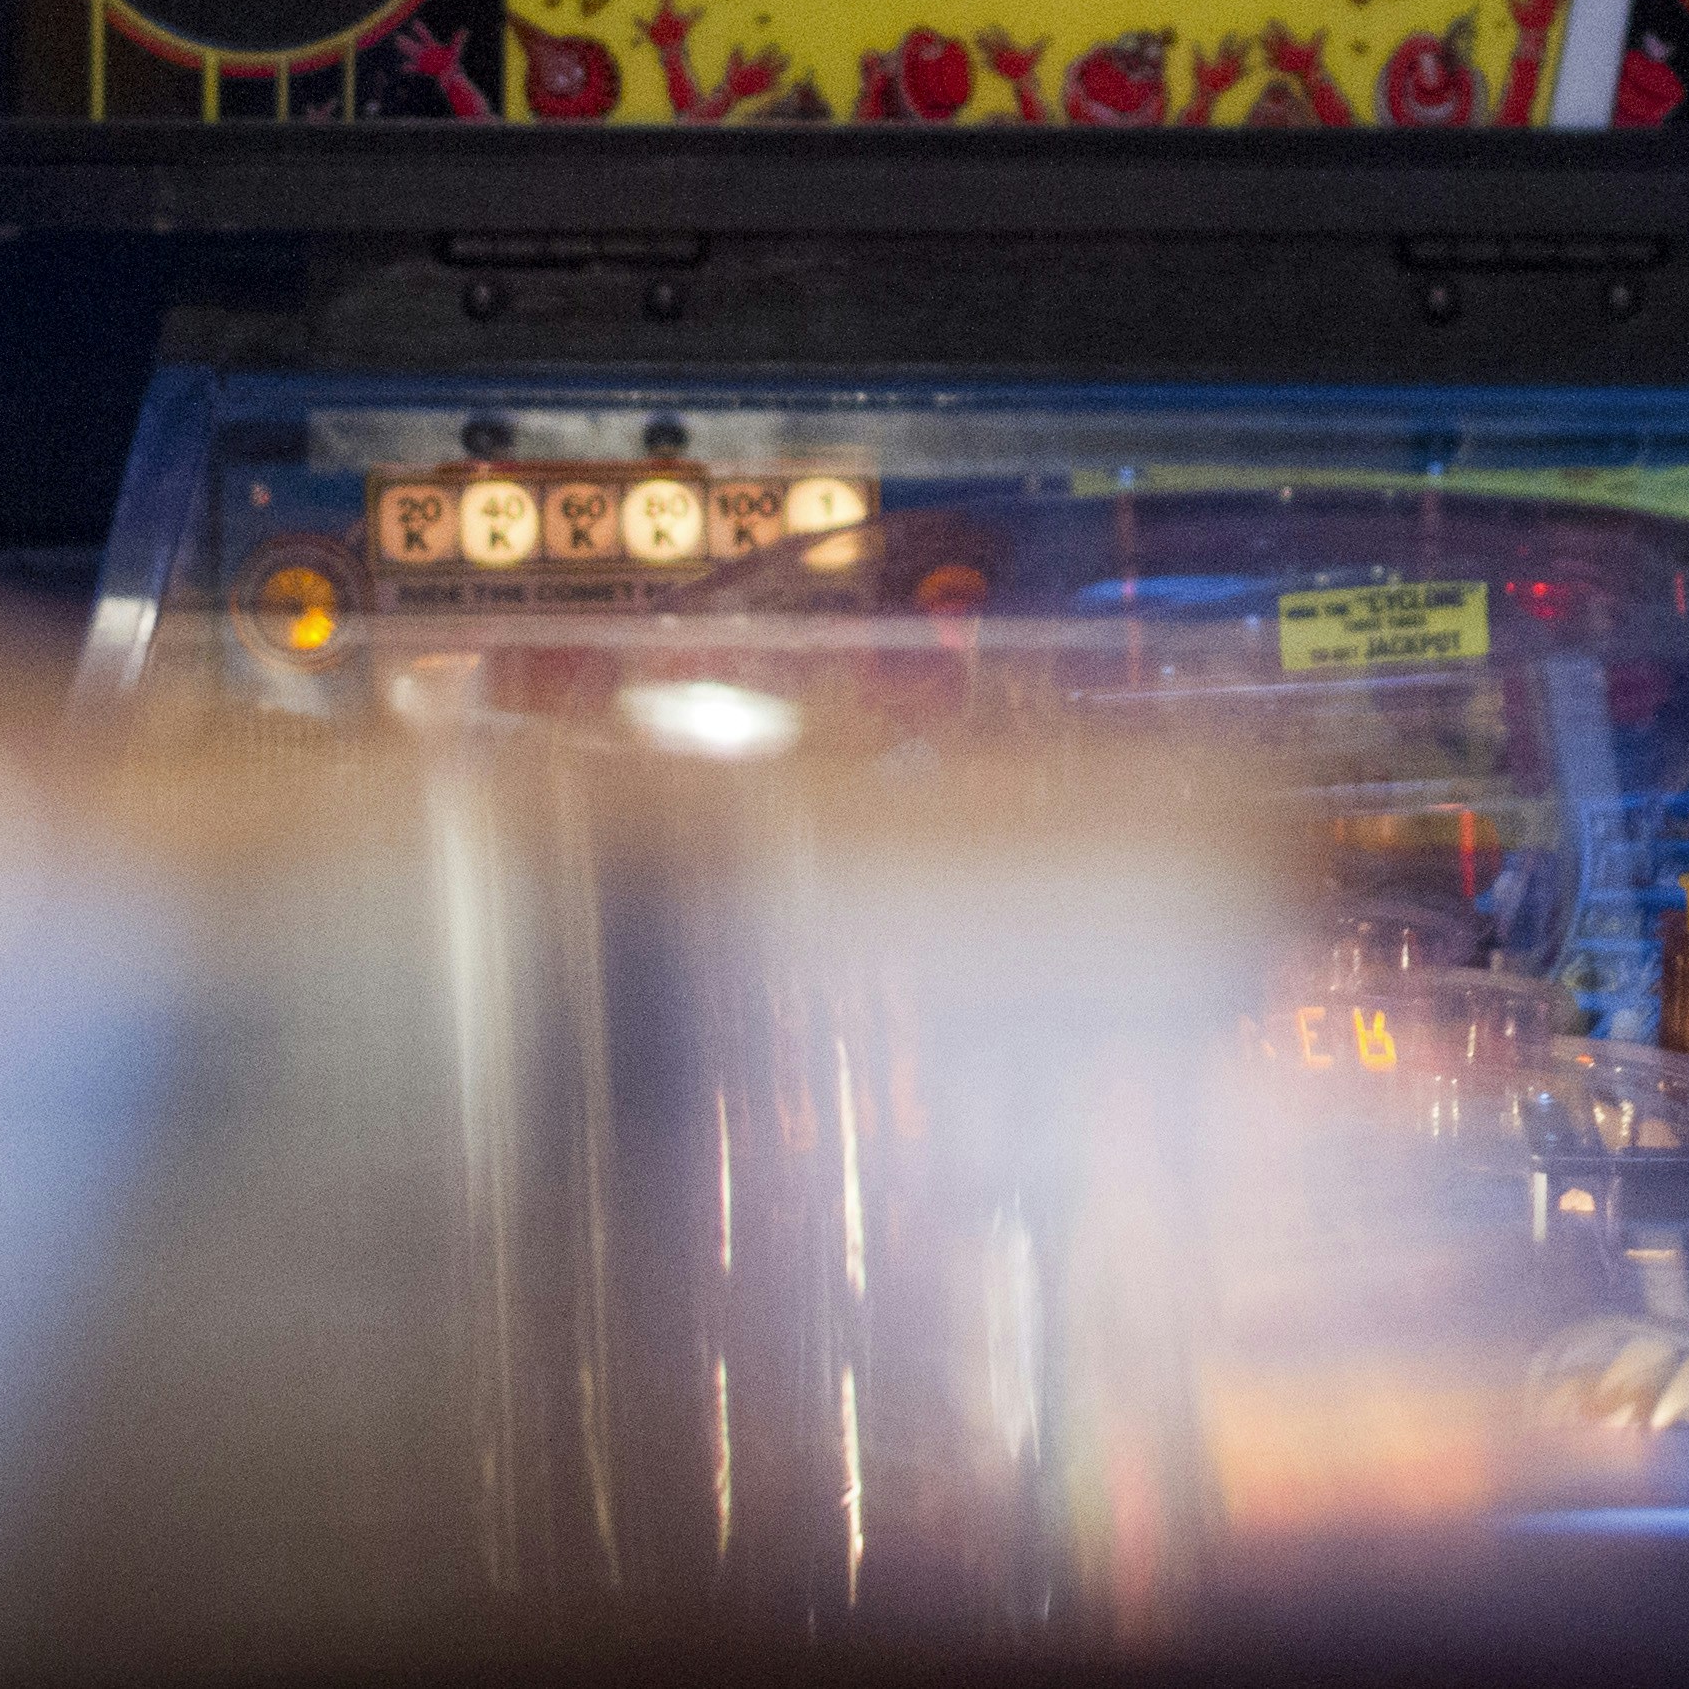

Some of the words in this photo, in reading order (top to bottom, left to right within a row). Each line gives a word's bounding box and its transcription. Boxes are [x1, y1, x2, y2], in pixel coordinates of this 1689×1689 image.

[397, 495, 443, 523] 20
[481, 494, 525, 521] 40
[561, 493, 607, 519] 60
[718, 492, 780, 519] 100
[405, 528, 429, 552] K
[489, 528, 511, 550] K
[571, 527, 594, 550] K
[653, 527, 675, 550] K
[735, 525, 756, 549] K
